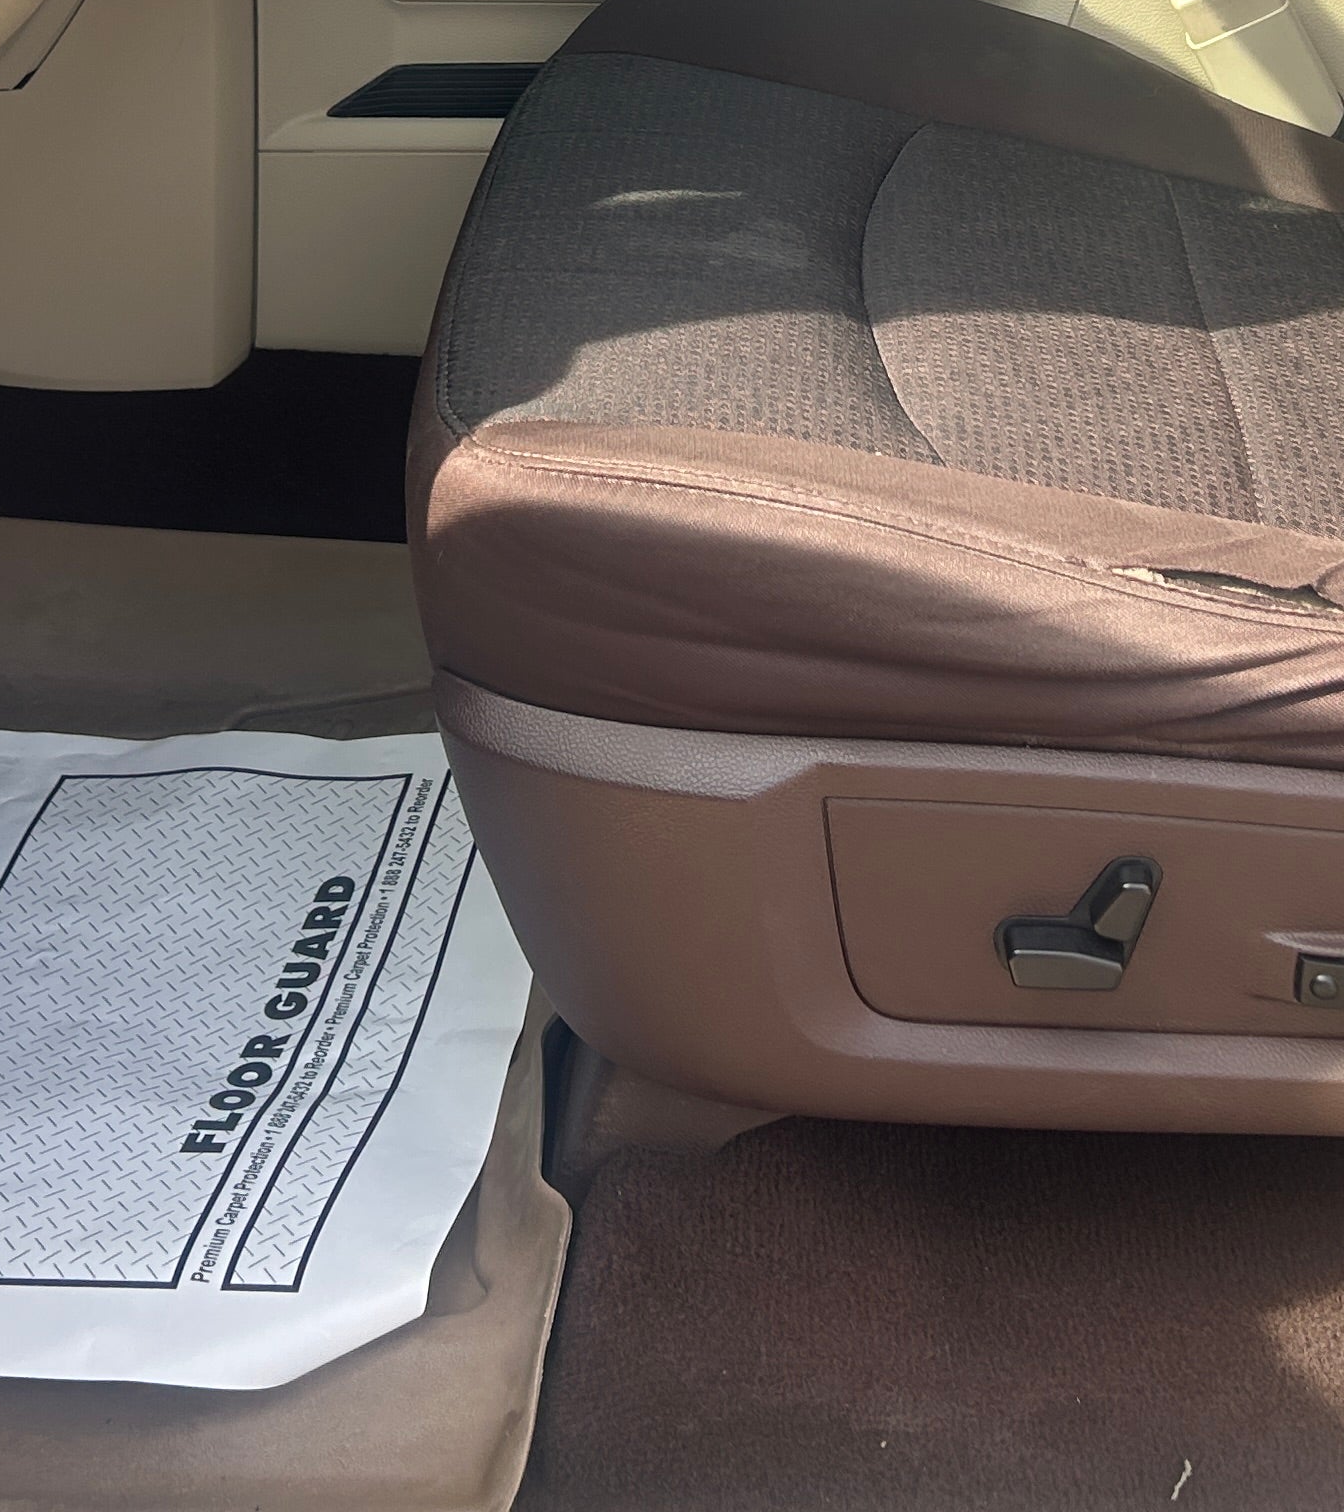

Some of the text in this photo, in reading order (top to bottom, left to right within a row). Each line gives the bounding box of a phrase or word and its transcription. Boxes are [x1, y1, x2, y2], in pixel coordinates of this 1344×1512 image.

[407, 778, 434, 813] Reorder
[405, 813, 421, 824] to
[388, 826, 417, 867] 247-5432
[381, 868, 402, 887] 888
[357, 901, 390, 951] Protection
[343, 950, 372, 981] Carpet
[179, 875, 356, 1153] FLOOR GUARD
[324, 983, 357, 1025] Premium
[304, 1031, 336, 1070] Reorder
[300, 1070, 318, 1081] to
[235, 1140, 275, 1196] Protection
[215, 1191, 248, 1226] Carpet
[191, 1228, 230, 1284] Premium
